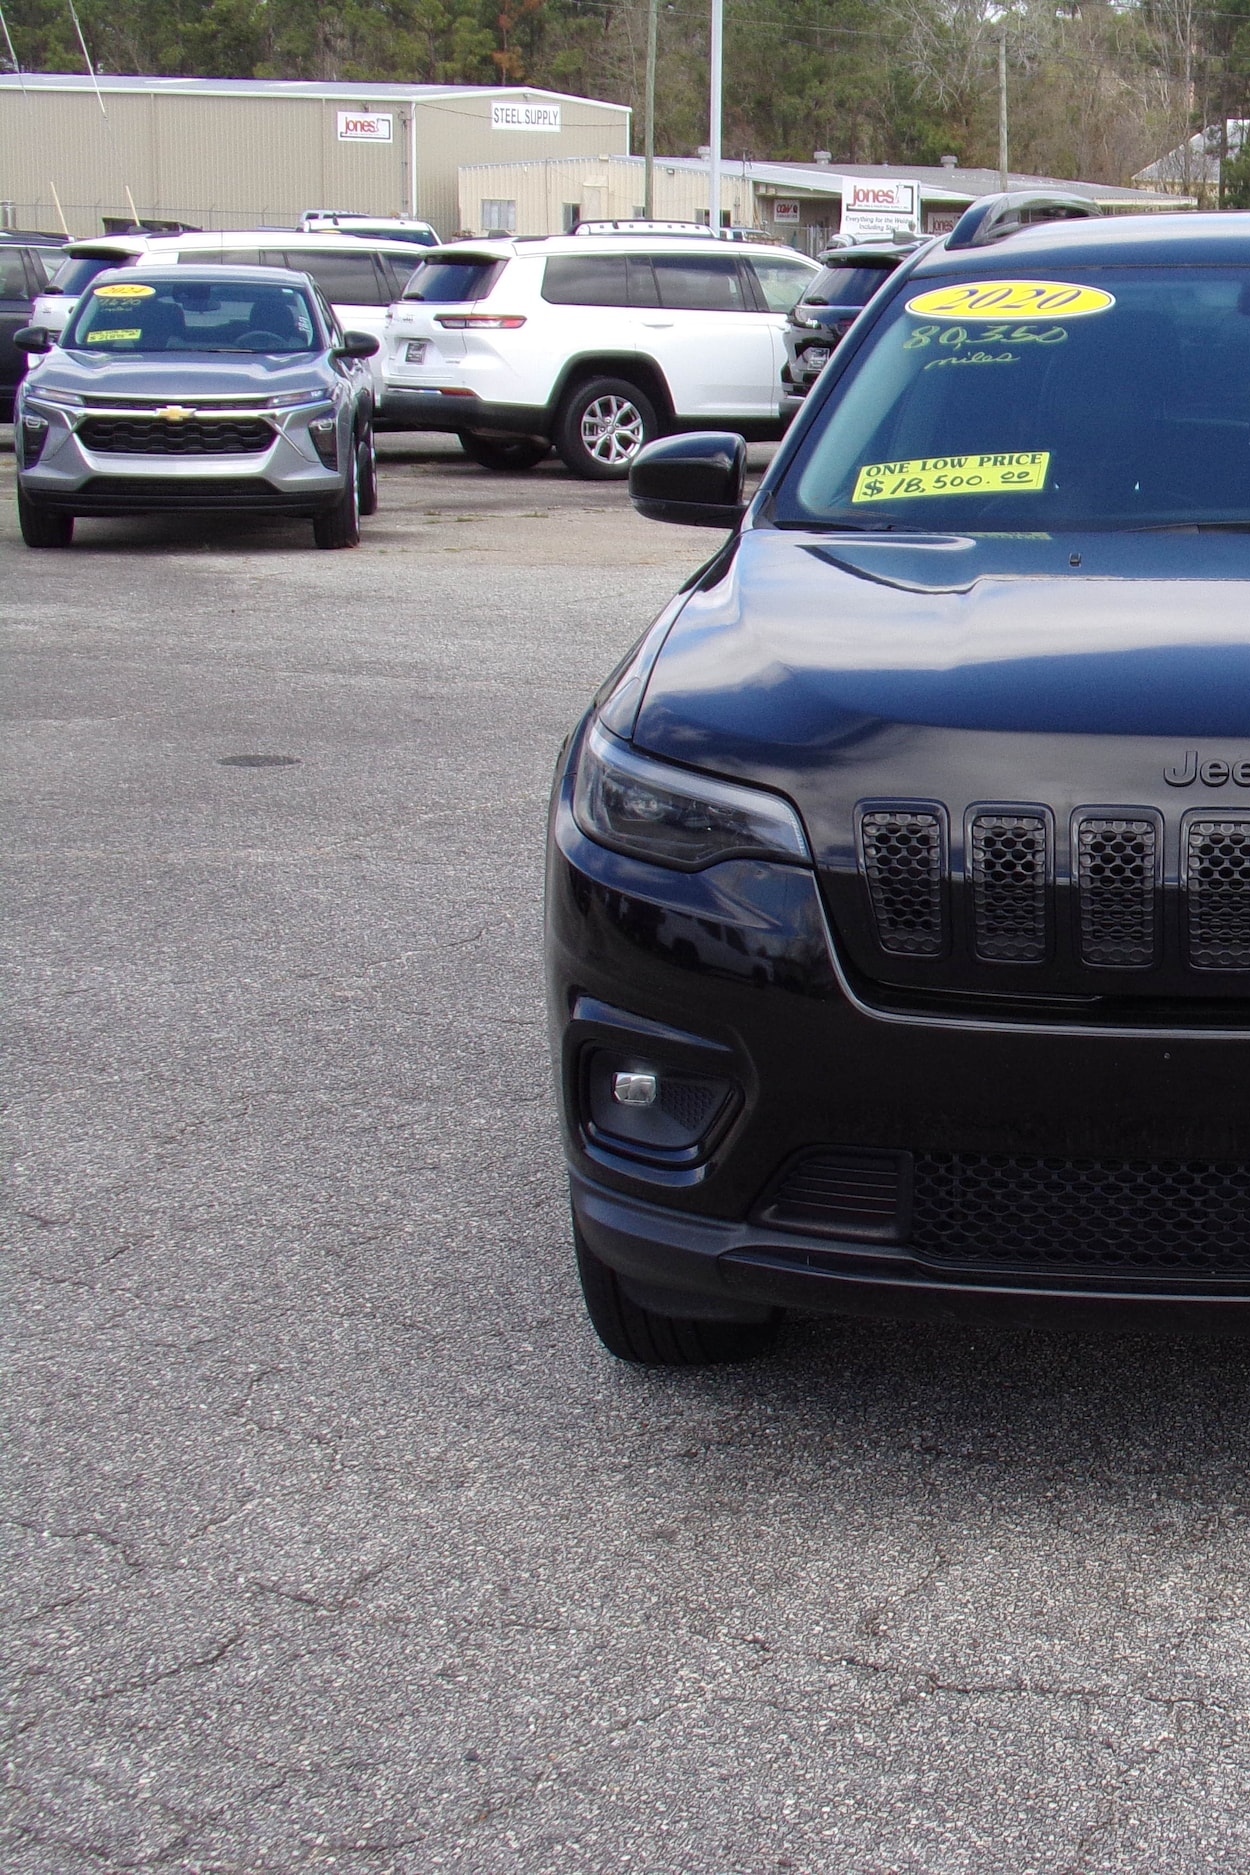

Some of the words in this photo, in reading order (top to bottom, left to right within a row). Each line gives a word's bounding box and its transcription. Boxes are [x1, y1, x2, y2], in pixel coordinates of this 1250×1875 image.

[493, 107, 522, 124] STEEL
[525, 108, 559, 126] SUPPLY
[929, 287, 1082, 310] 2020
[903, 325, 1069, 350] 80,350
[924, 351, 1021, 370] miles
[865, 462, 911, 477] ONE
[920, 457, 969, 472] LOW
[978, 453, 1043, 467] PRICE
